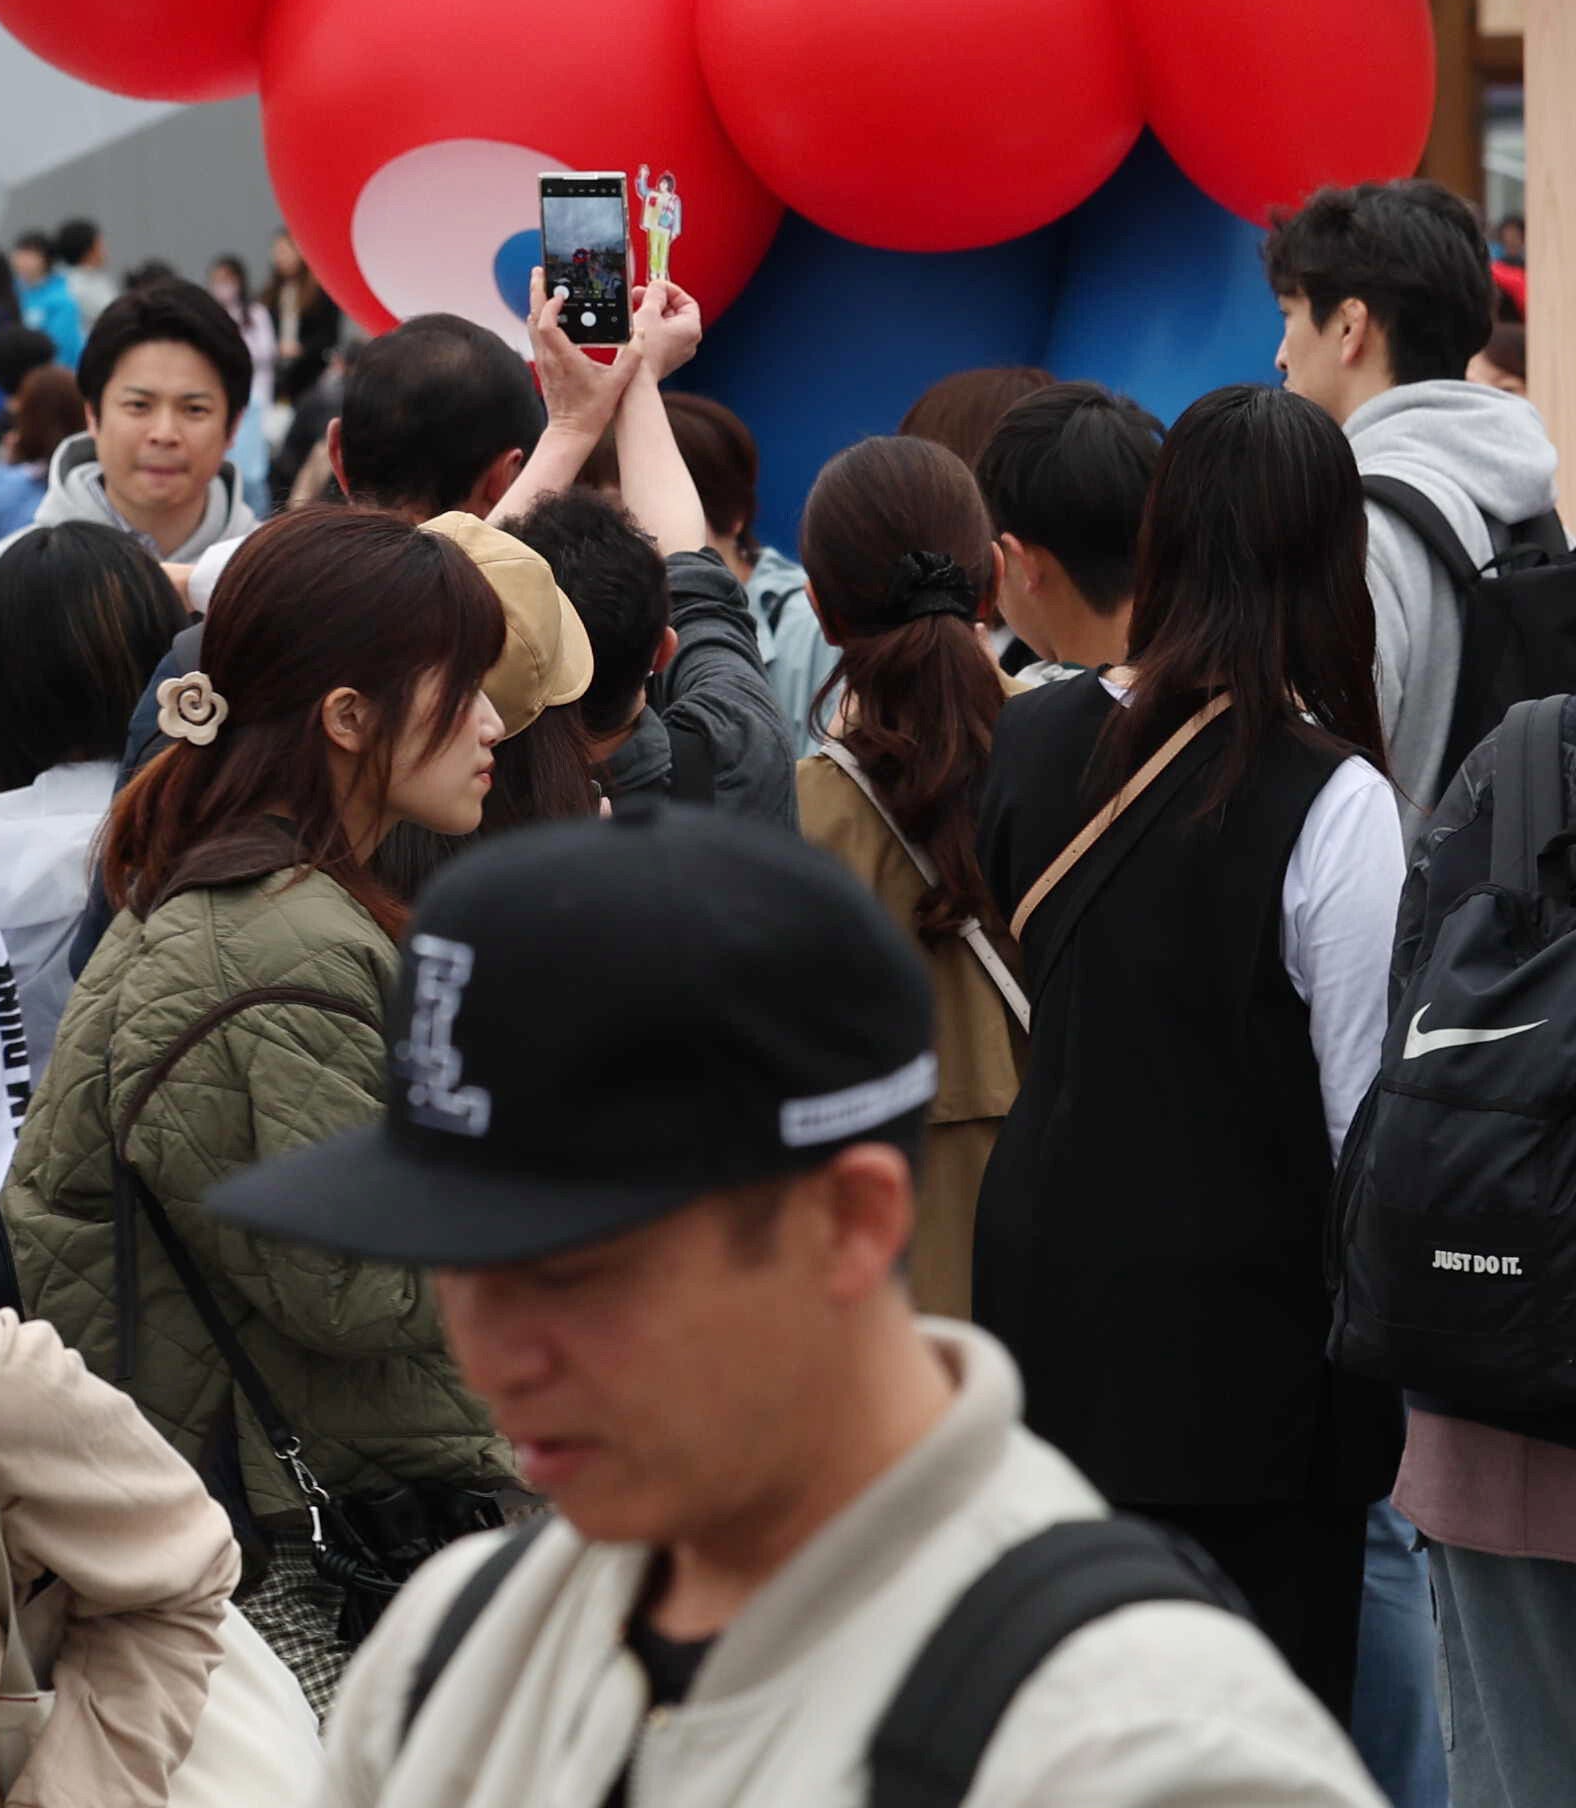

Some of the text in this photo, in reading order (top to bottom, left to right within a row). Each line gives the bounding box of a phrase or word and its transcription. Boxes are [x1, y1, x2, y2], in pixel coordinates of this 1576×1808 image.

[1432, 1250, 1523, 1275] JUST DO IT.
